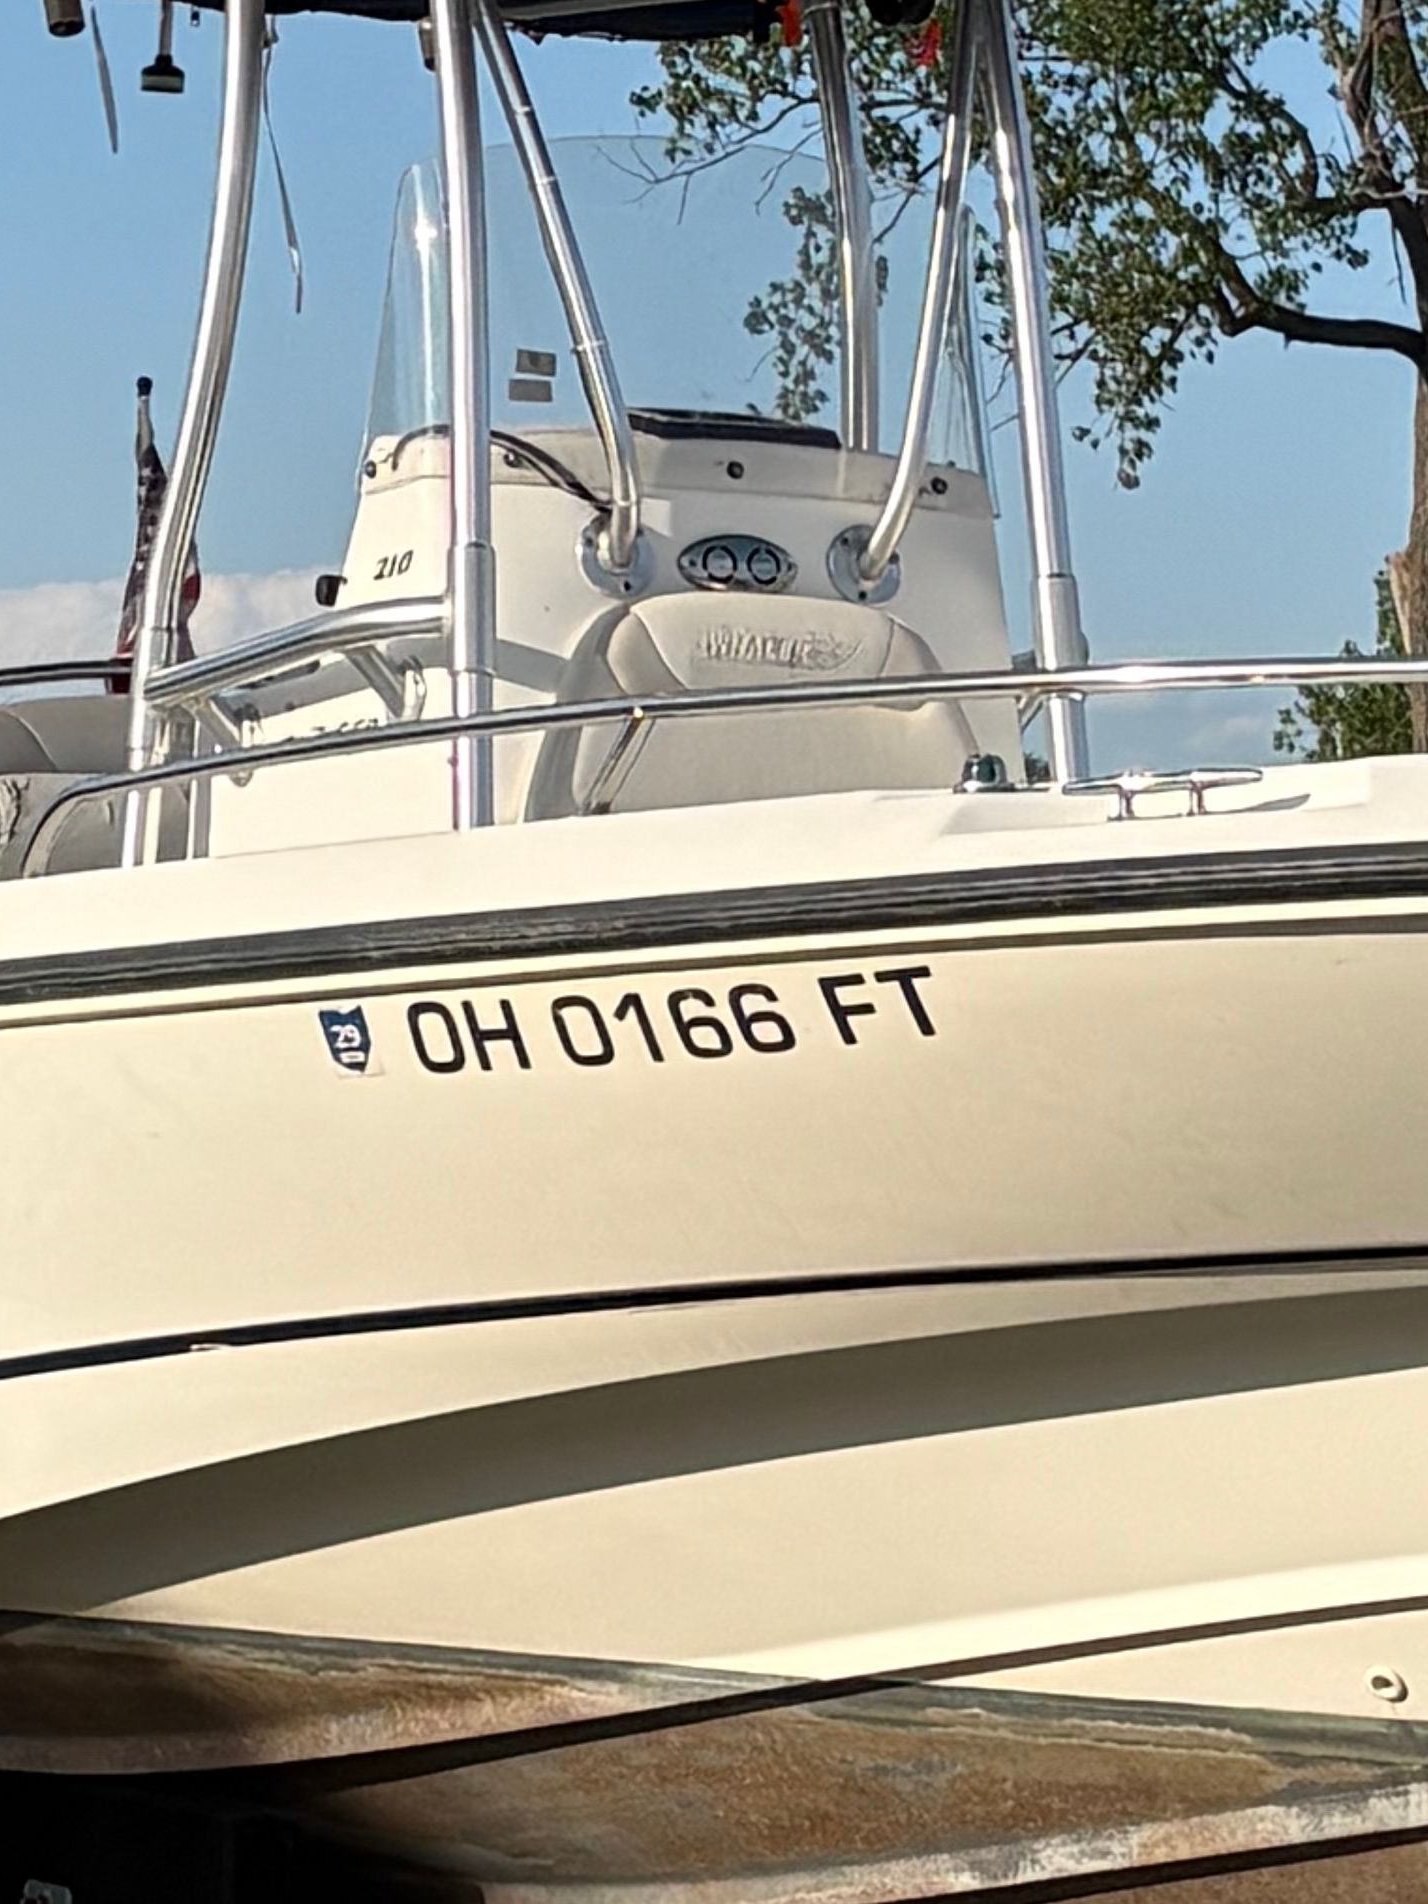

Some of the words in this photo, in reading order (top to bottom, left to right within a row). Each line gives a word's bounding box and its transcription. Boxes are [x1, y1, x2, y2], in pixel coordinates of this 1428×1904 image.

[373, 549, 414, 581] 210
[406, 997, 532, 1074] OH
[551, 982, 797, 1067] 0166
[818, 965, 937, 1046] FT
